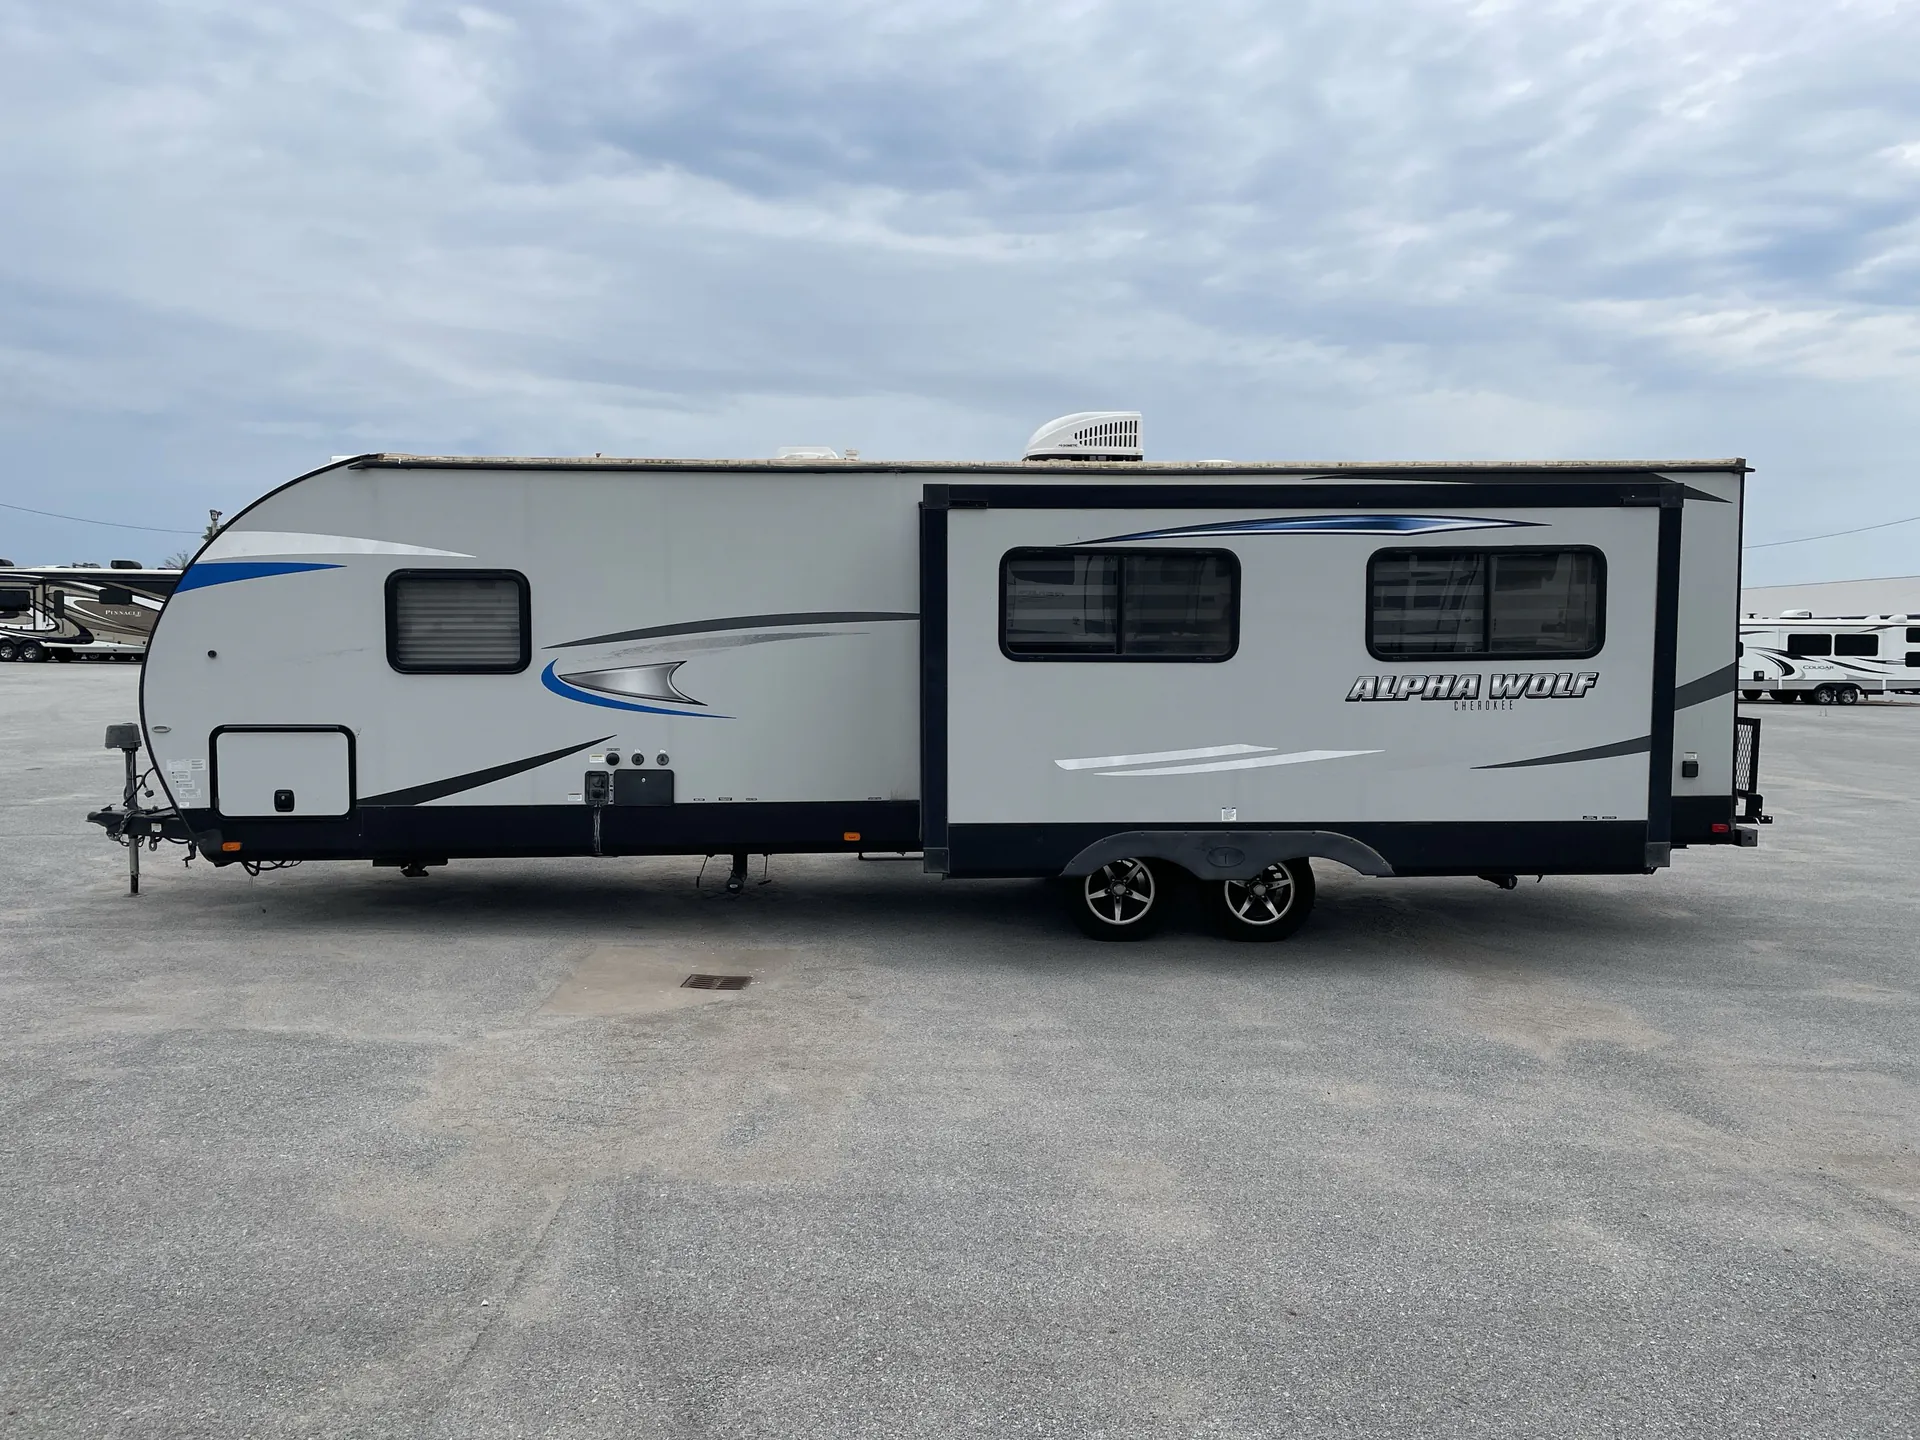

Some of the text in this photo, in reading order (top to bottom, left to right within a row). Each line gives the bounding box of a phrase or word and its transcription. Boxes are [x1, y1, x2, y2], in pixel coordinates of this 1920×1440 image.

[1345, 672, 1600, 702] ALPHA WOLF
[1453, 700, 1514, 711] CHEROKEE
